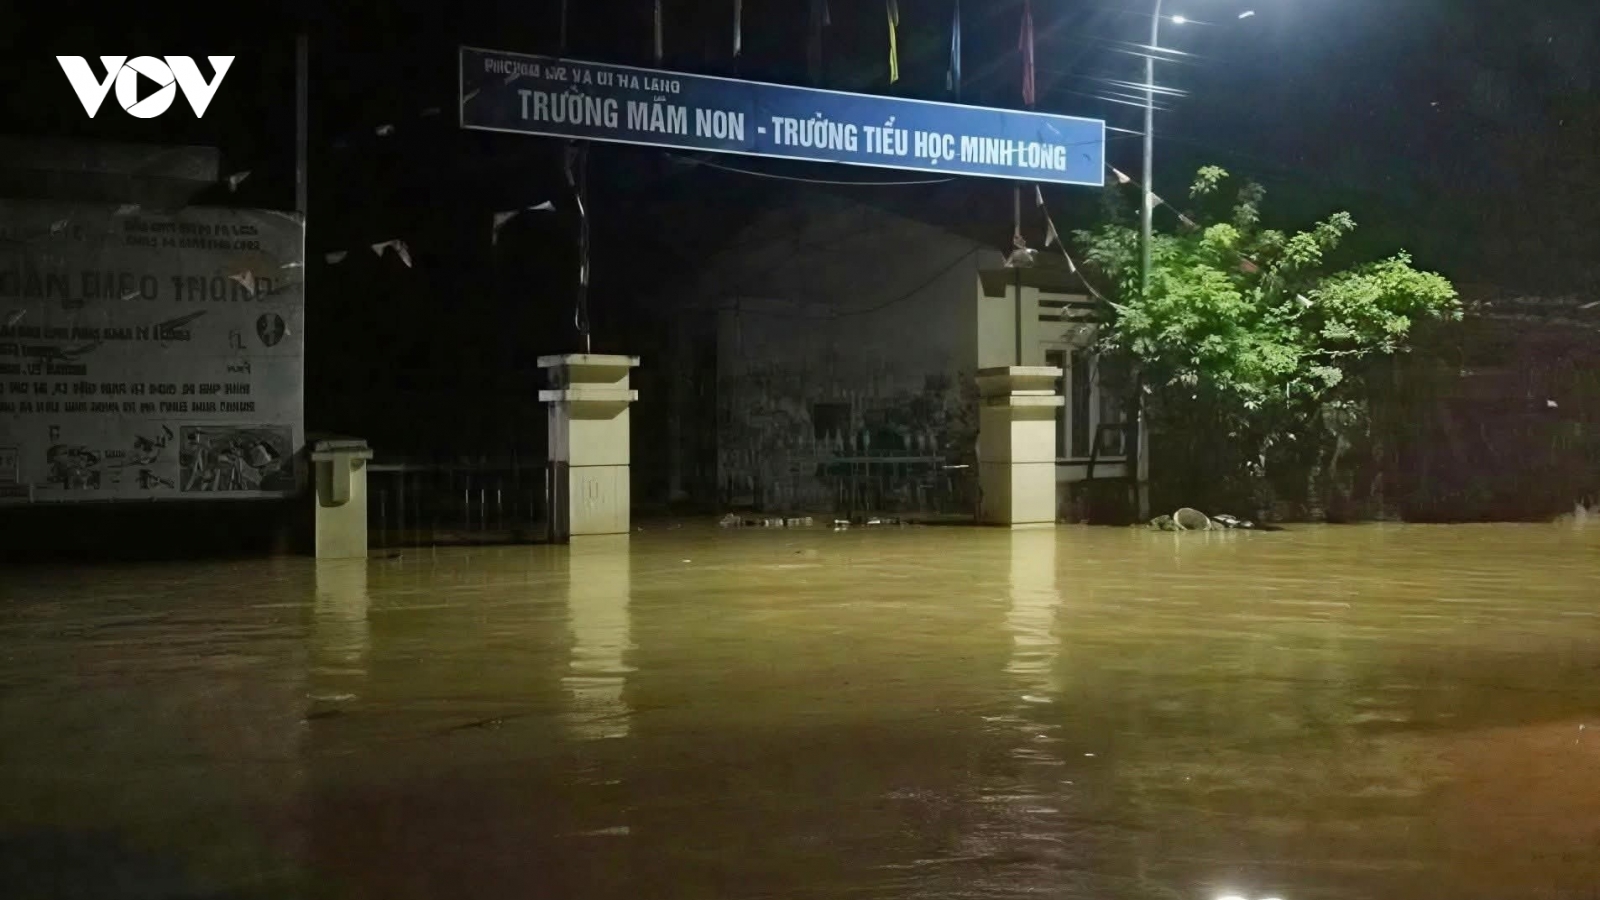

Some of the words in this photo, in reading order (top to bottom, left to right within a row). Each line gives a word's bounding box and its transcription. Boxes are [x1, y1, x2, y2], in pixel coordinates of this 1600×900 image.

[517, 84, 618, 129] TRƯỜNG
[696, 108, 745, 141] NON
[771, 112, 858, 152] TRƯỜNG
[863, 116, 908, 156] TIỂU
[914, 133, 955, 165] HỌC
[960, 136, 1012, 167] MINH
[1017, 140, 1067, 171] LONG
